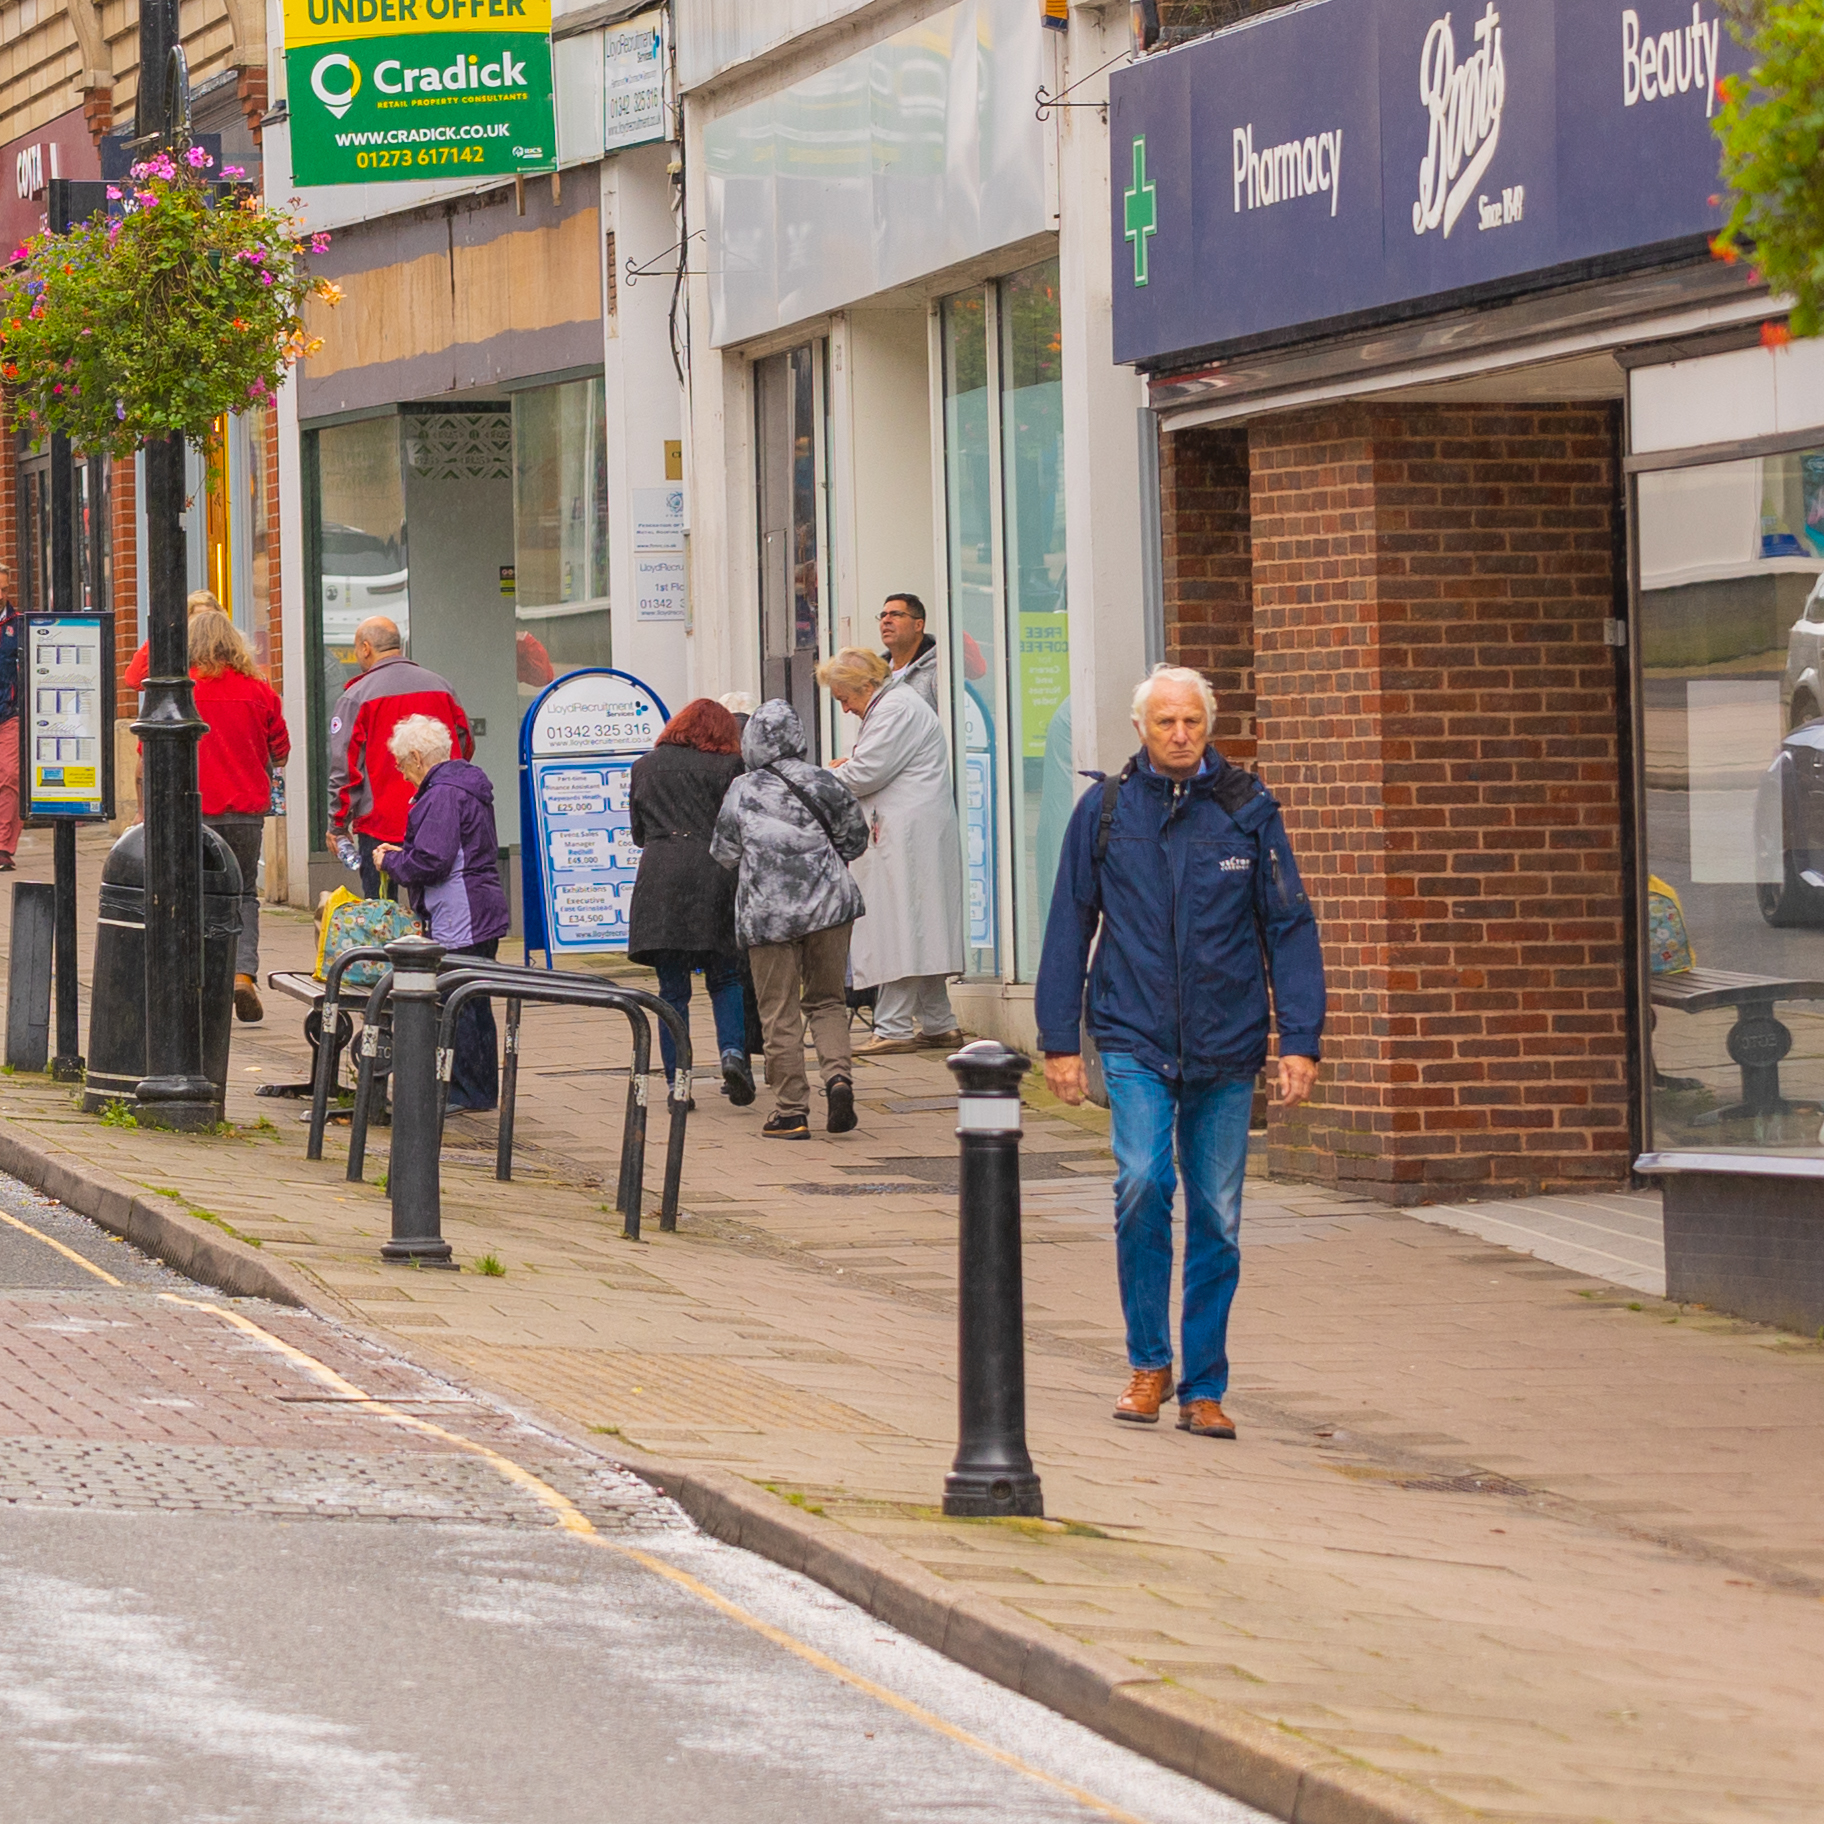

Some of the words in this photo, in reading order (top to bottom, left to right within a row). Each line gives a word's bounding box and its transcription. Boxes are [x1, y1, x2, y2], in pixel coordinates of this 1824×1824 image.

[1622, 2, 1719, 117] Beauty
[373, 51, 527, 94] Cradick
[377, 99, 408, 109] RETAIL
[411, 96, 459, 107] PROPERTY
[462, 92, 528, 104] CONSULTANTS
[1413, 2, 1505, 239] Boots
[335, 123, 510, 148] WWW.CRADICK.CO.UK
[356, 149, 413, 169] 01273
[417, 145, 484, 166] 617142
[16, 143, 44, 201] COSTA
[1233, 123, 1342, 217] Pharmacy
[655, 583, 669, 592] 1st
[639, 599, 672, 609] 01342
[547, 725, 591, 739] 01342
[594, 724, 620, 737] 325
[624, 723, 651, 735] 316
[557, 803, 593, 812] £25,000
[566, 897, 605, 905] Executive
[568, 914, 604, 923] £34,500
